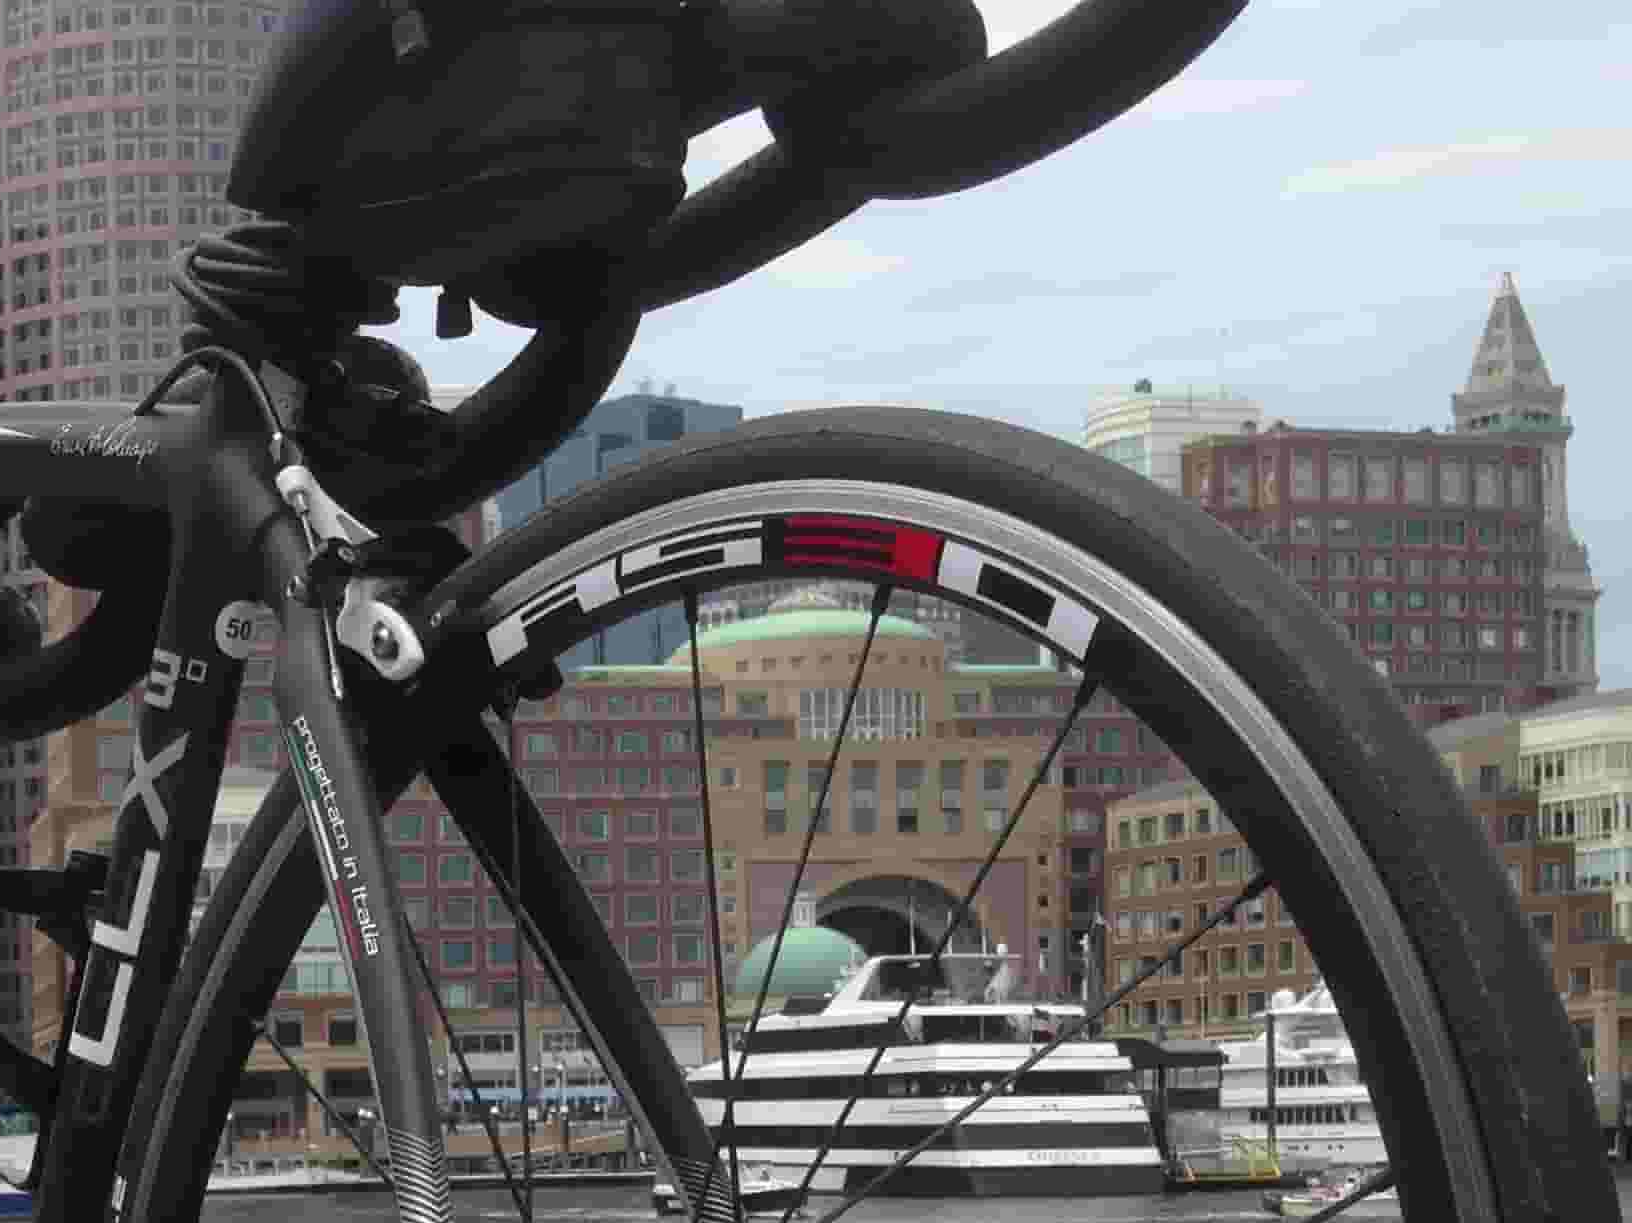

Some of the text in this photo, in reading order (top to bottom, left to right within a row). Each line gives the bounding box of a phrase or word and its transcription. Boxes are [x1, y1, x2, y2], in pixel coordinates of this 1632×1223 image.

[225, 617, 251, 640] 50
[342, 854, 358, 880] in
[351, 886, 379, 956] Italia
